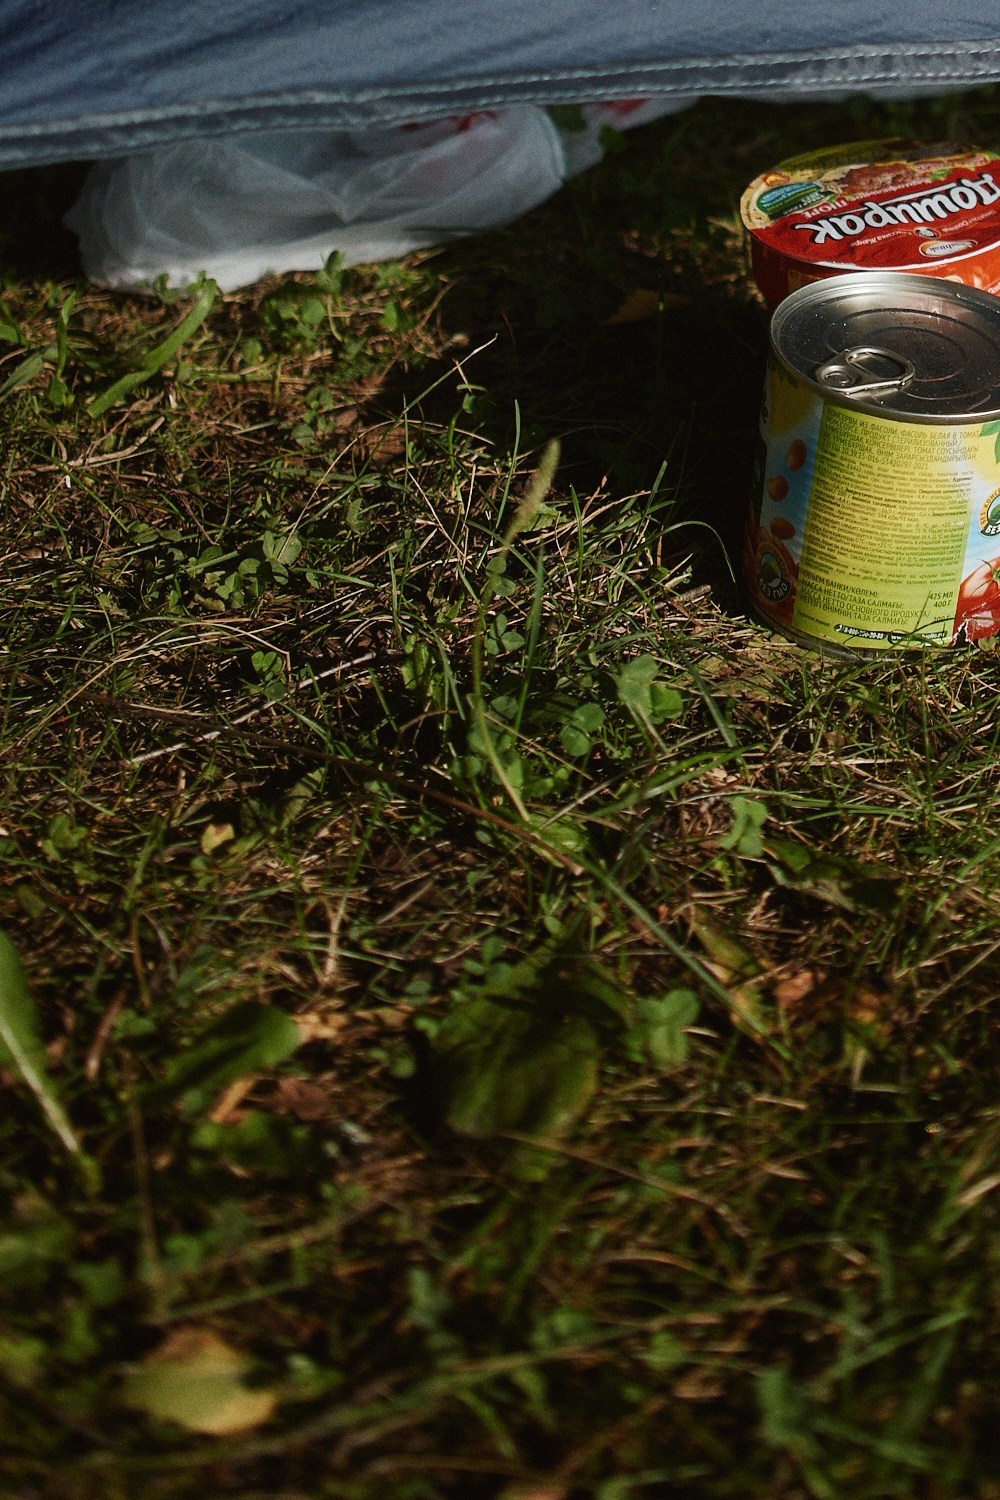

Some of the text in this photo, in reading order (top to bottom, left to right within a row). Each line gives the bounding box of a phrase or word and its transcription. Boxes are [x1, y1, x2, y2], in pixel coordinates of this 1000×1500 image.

[822, 595, 845, 608] НЕТТО
[932, 600, 946, 608] 400
[853, 611, 871, 621] ТАЗА
